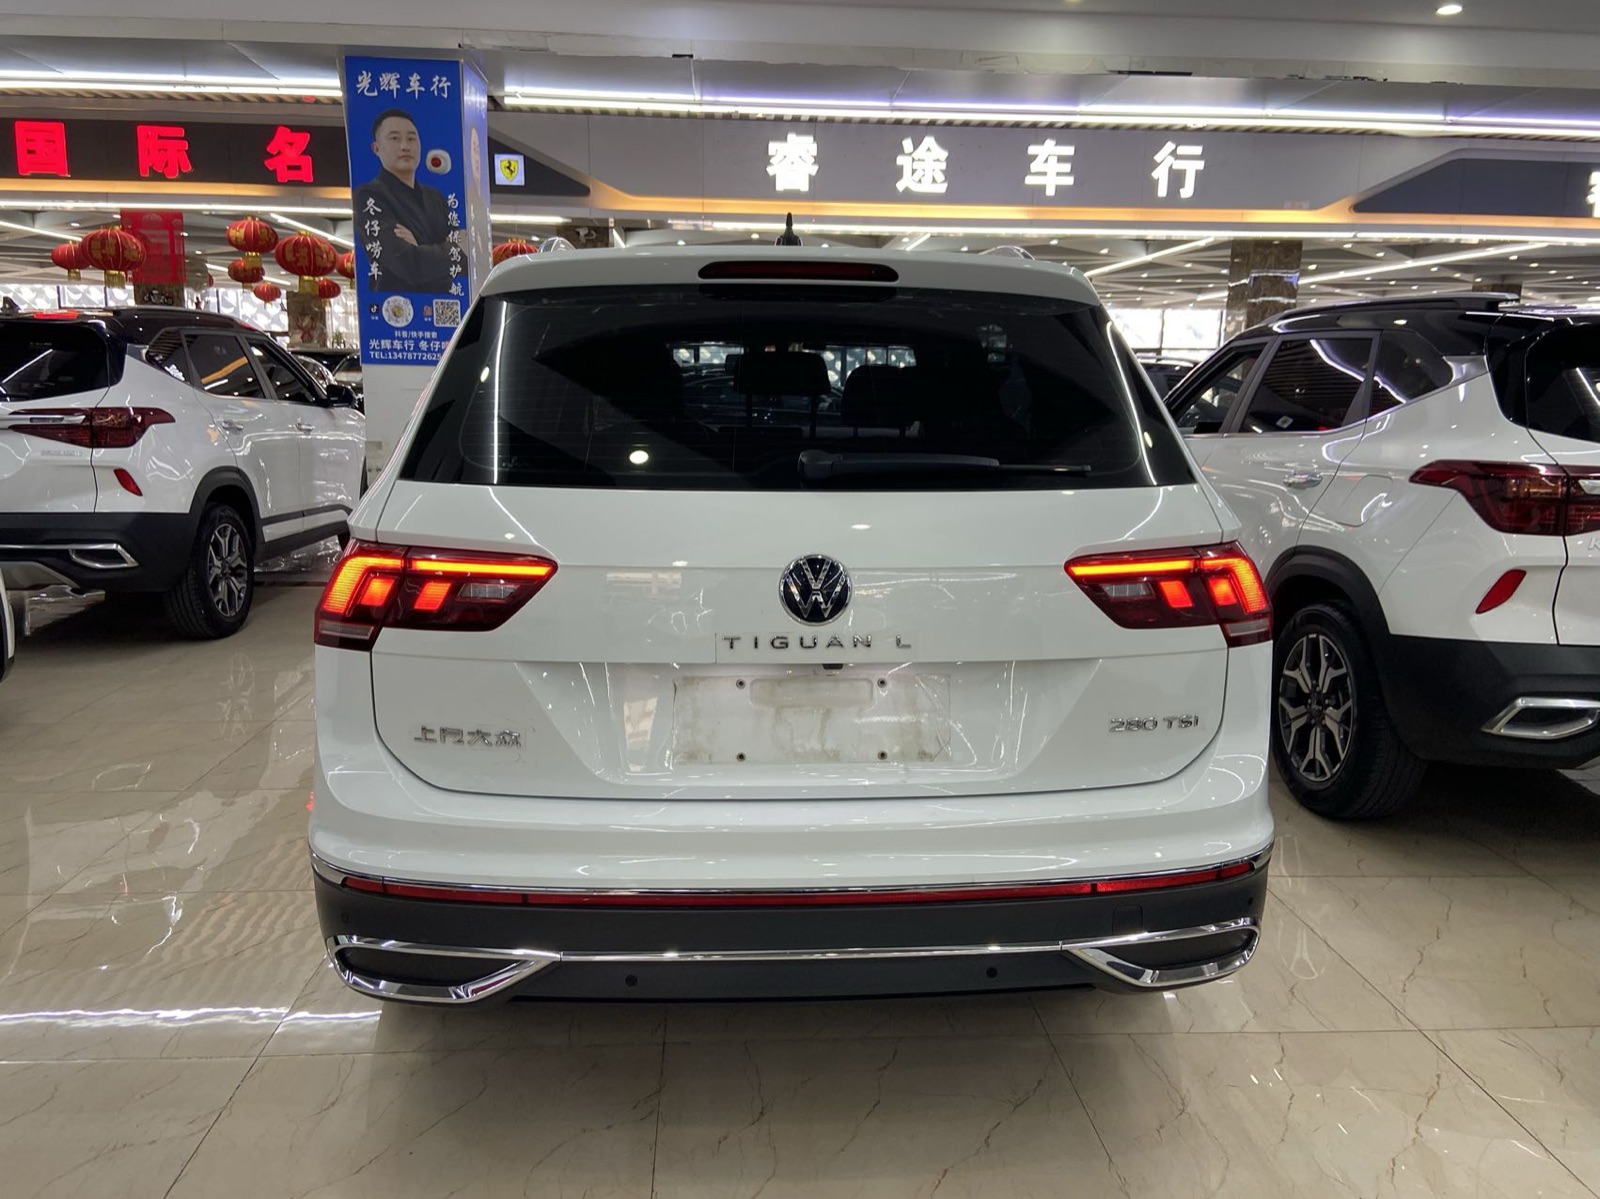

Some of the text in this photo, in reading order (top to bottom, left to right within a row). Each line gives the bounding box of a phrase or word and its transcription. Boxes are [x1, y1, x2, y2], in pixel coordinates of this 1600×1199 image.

[355, 70, 451, 99] 光辉车行
[767, 132, 1205, 199] 睿途车行
[447, 192, 465, 297] 为您保驾护航
[369, 339, 415, 351] 光辉车行
[723, 634, 912, 649] TIGUAN L
[1109, 714, 1200, 732] 280 TSI
